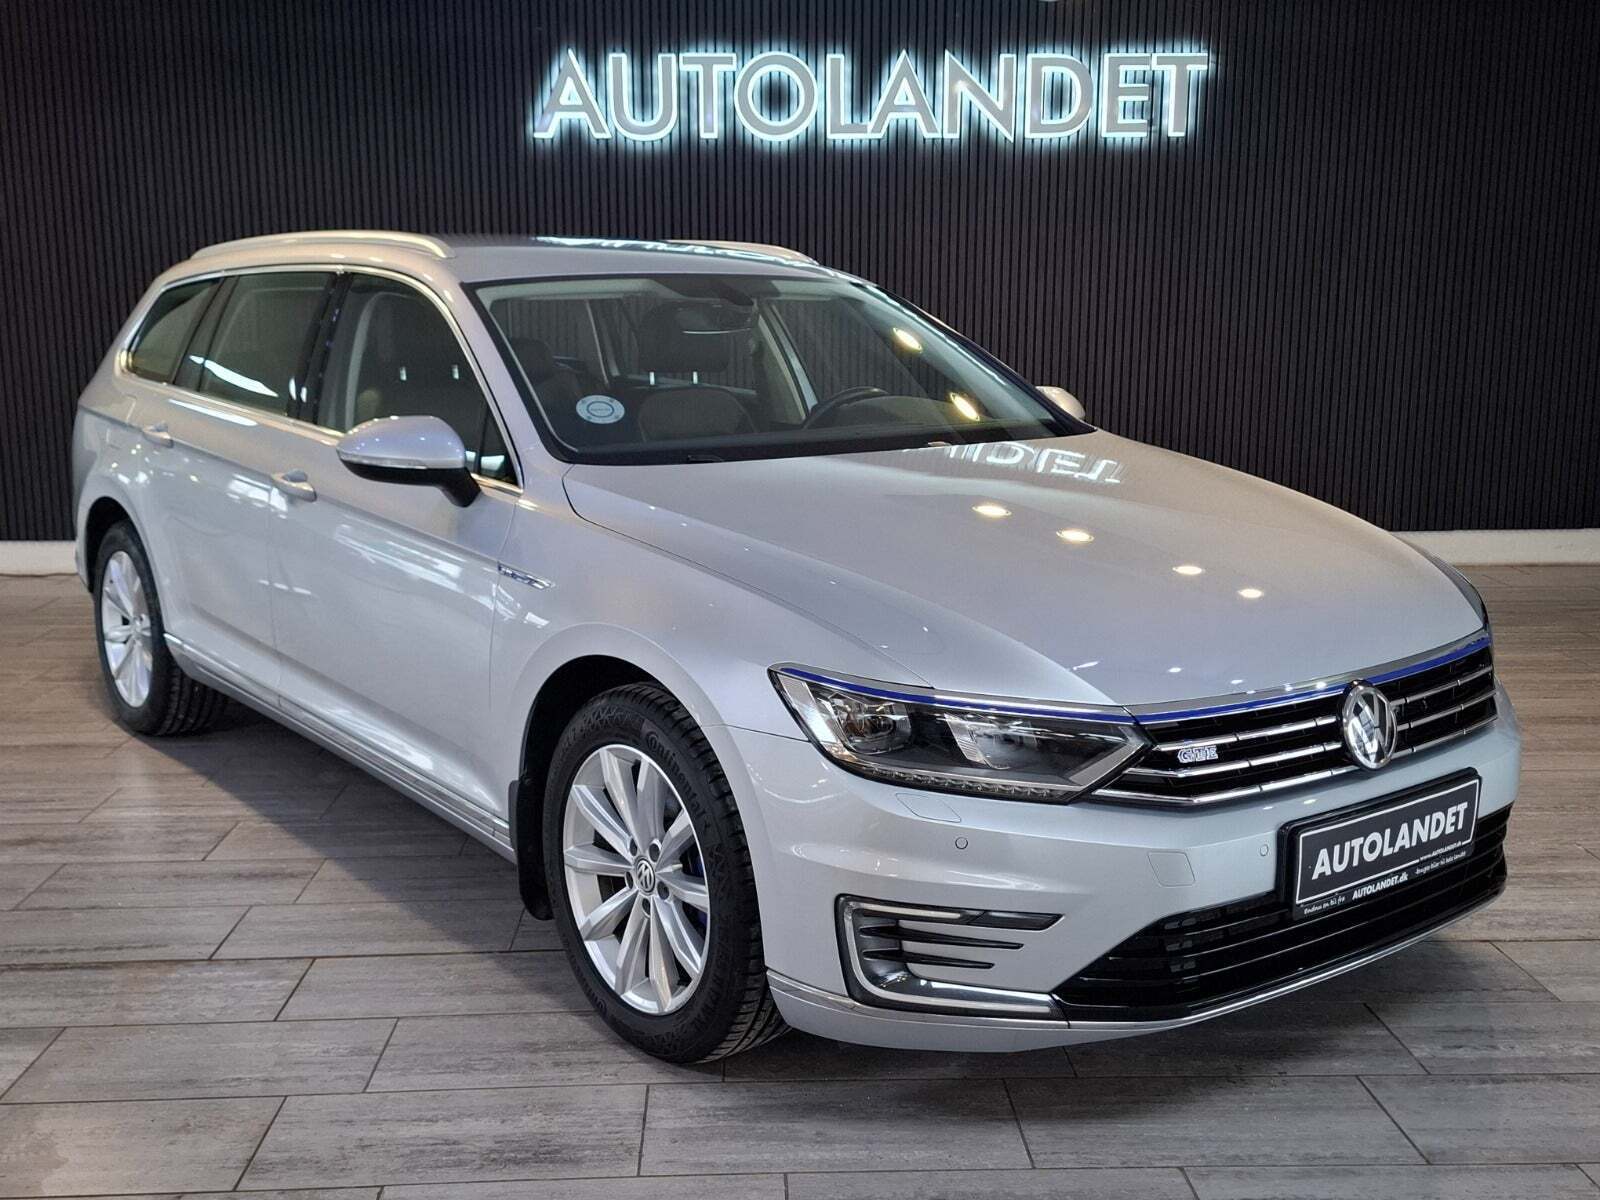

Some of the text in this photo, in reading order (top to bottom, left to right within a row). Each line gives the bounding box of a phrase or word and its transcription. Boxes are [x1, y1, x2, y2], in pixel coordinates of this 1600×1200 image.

[533, 49, 1208, 143] AUTOLANDET
[1311, 801, 1468, 880] AUTOLANDET
[1352, 871, 1408, 900] AUTOLANDET.dk
